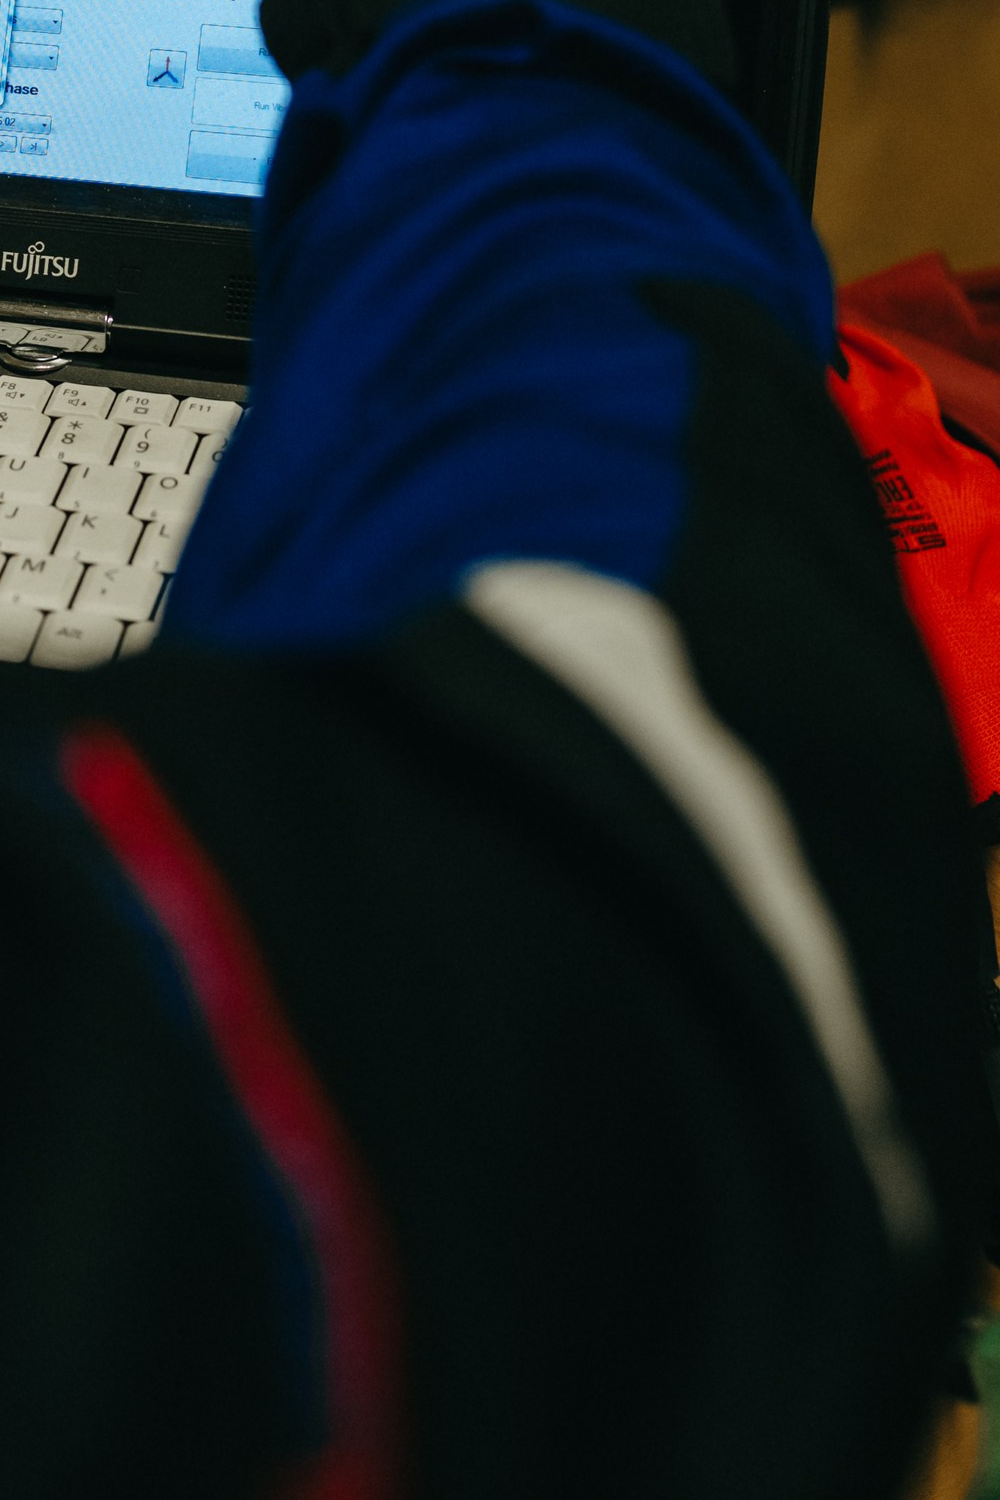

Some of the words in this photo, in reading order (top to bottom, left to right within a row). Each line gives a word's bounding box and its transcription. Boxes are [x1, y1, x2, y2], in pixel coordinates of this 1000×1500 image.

[1, 246, 79, 280] FUJITSU
[1, 382, 17, 390] F8
[63, 388, 79, 397] F9
[126, 396, 149, 405] F10
[189, 403, 212, 412] F11
[61, 433, 76, 444] 8
[137, 441, 149, 453] 9
